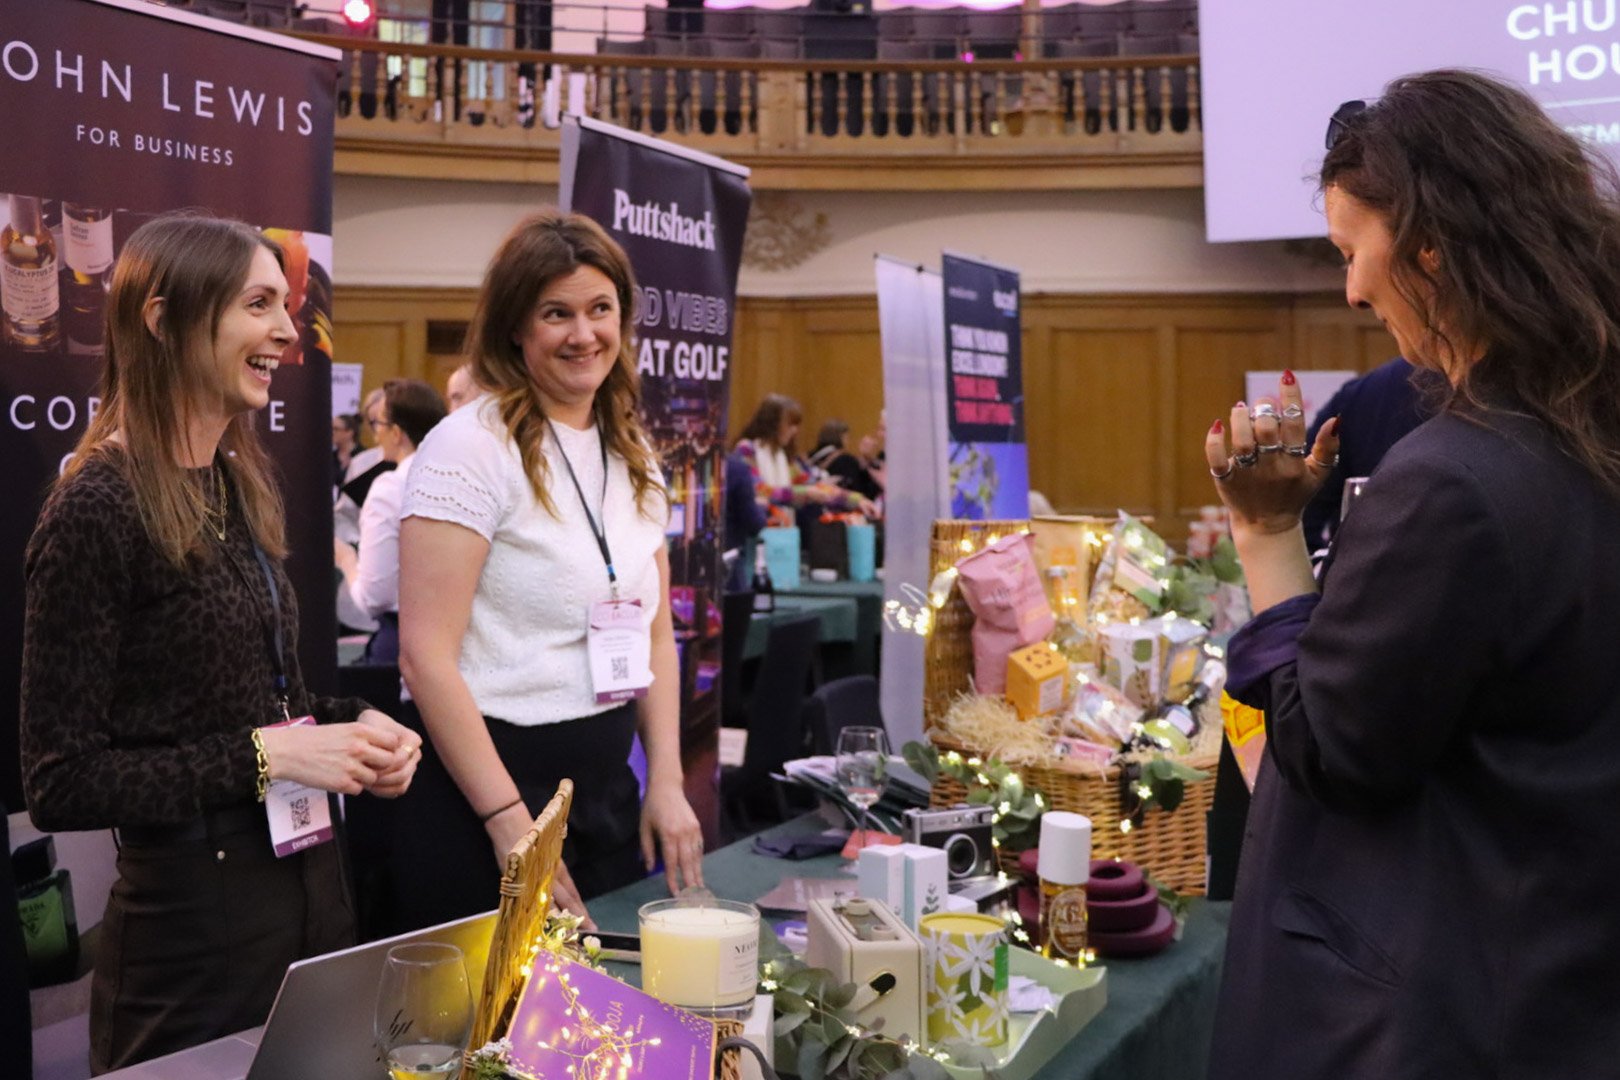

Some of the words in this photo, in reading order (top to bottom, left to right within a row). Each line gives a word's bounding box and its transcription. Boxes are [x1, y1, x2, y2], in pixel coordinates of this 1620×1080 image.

[2, 40, 132, 102] OHN
[162, 72, 313, 136] LEWIS
[76, 124, 121, 148] FOR
[134, 134, 234, 167] BUSINESS
[612, 188, 716, 250] Puttshack
[630, 336, 671, 378] AT
[673, 340, 729, 381] GOLF
